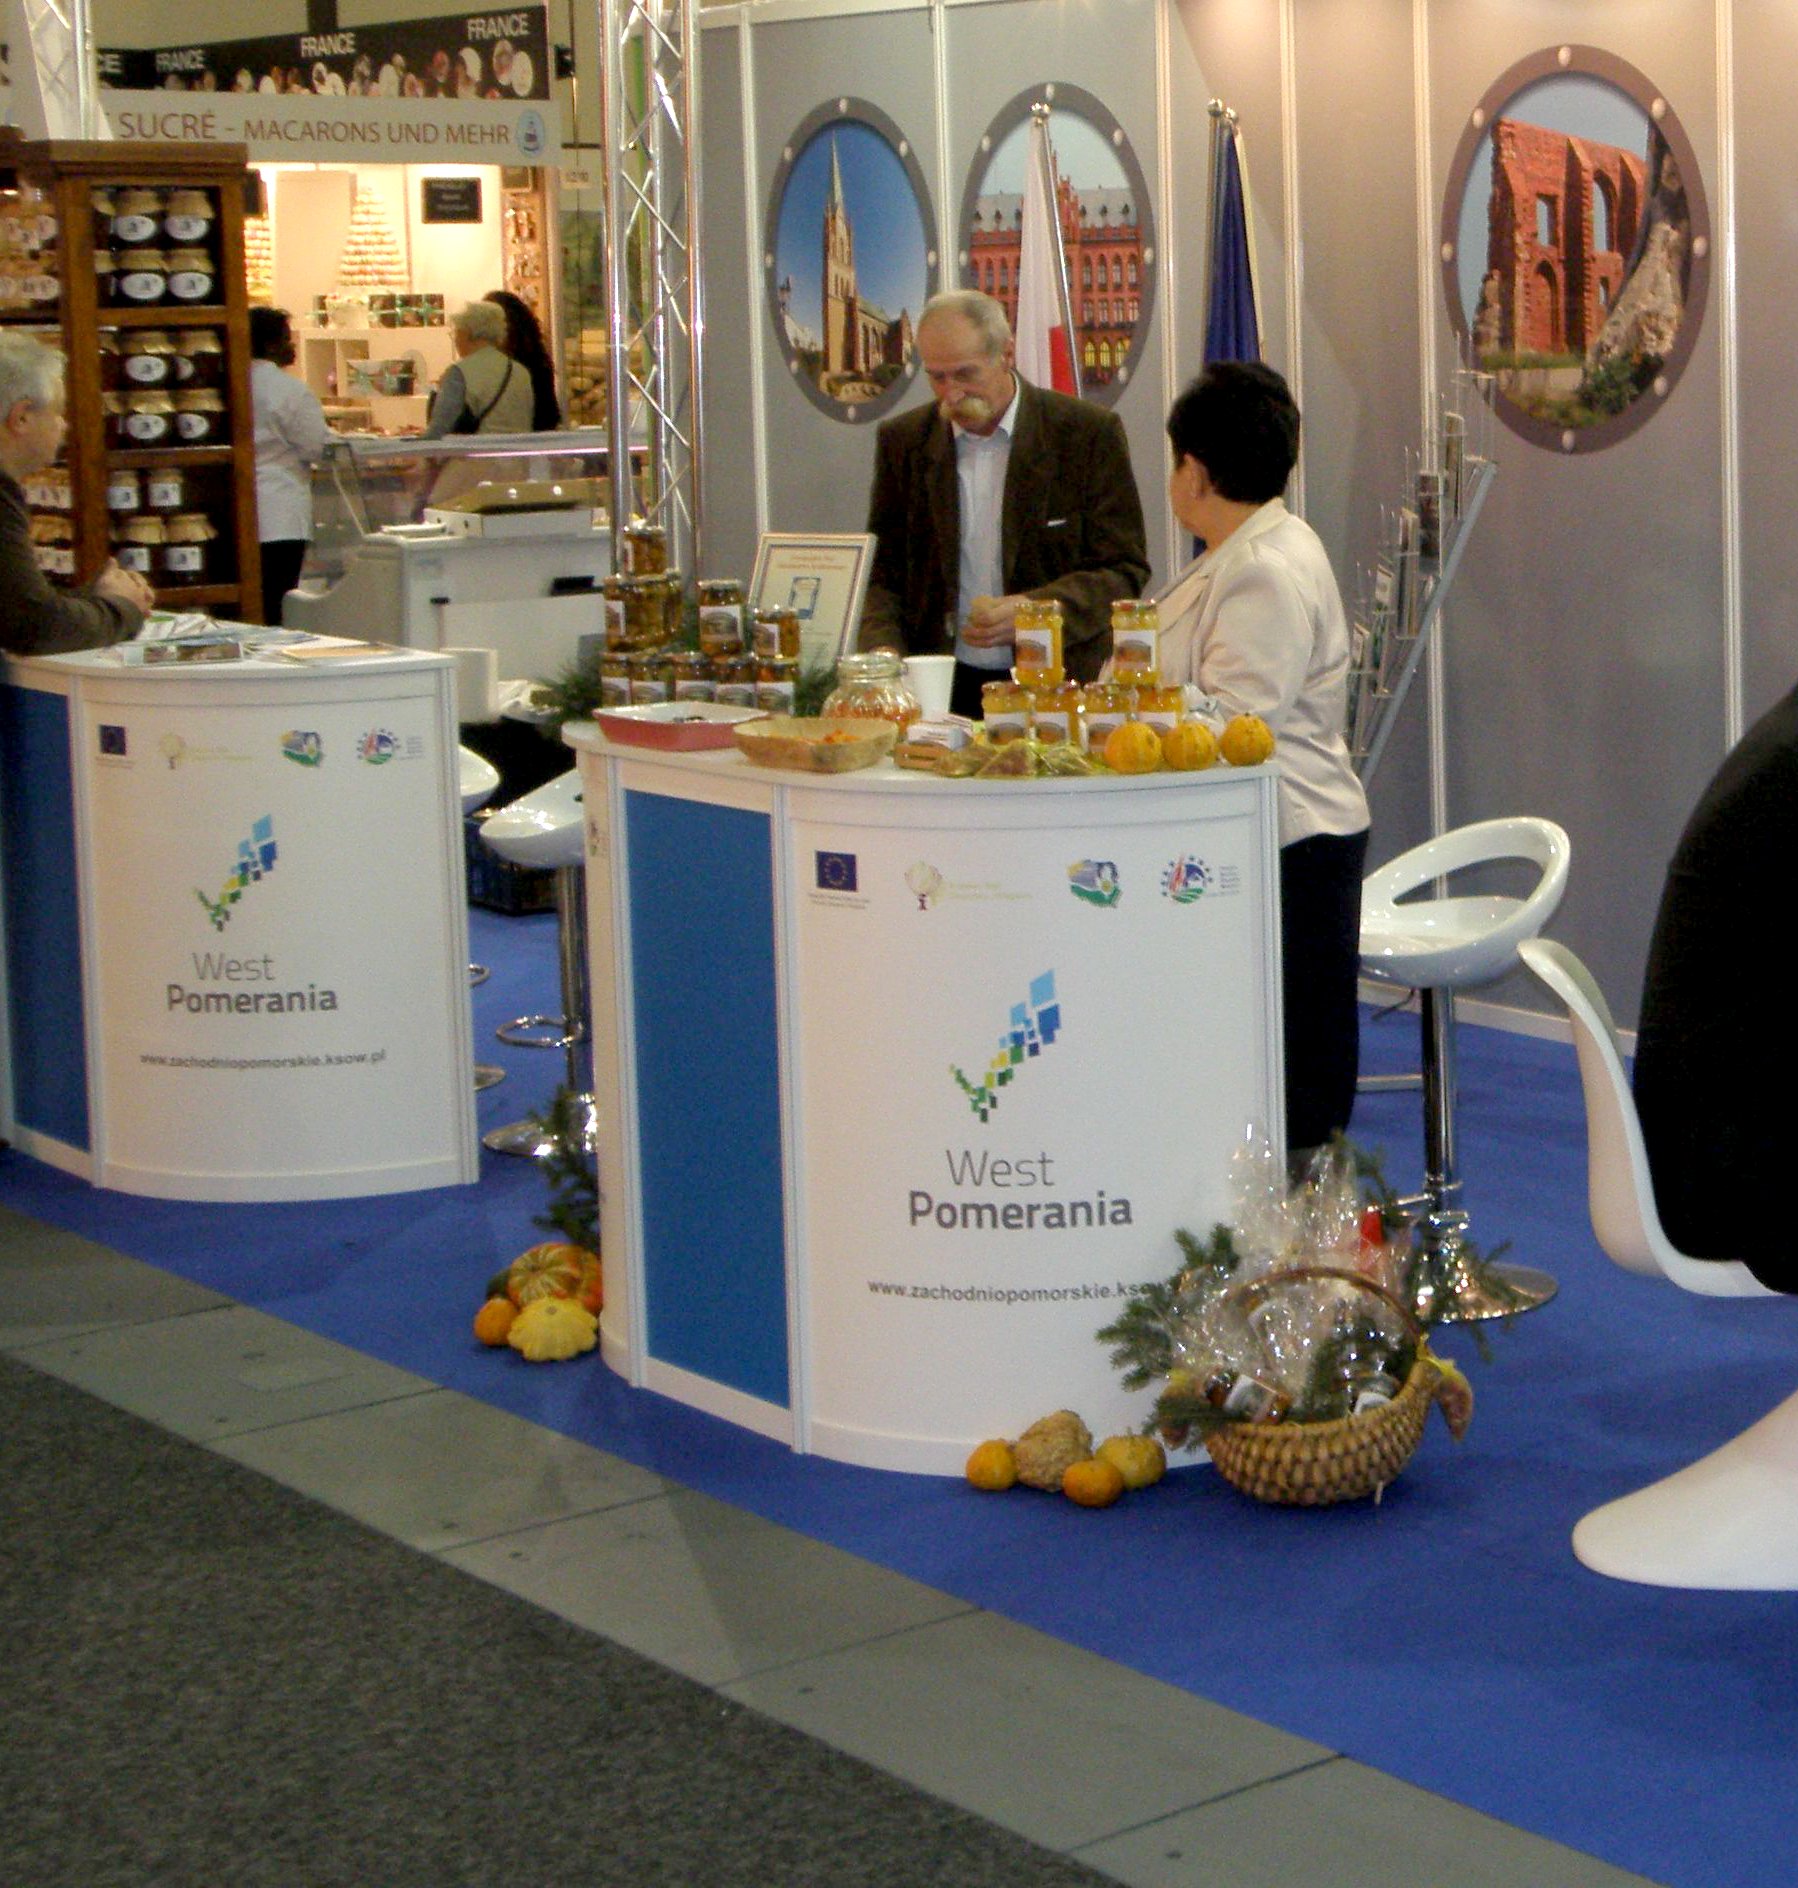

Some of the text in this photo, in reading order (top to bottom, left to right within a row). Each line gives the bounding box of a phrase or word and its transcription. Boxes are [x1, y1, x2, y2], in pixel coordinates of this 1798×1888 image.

[467, 13, 531, 40] FRANCE
[301, 32, 356, 57] FRANCE
[156, 50, 205, 72] FRANCE
[119, 109, 217, 140] SUCRÉ
[243, 118, 381, 144] MACARONS
[387, 123, 439, 145] UND
[446, 124, 511, 146] MEHR
[191, 951, 276, 982] West
[166, 982, 339, 1015] Pomerania
[945, 1149, 1056, 1188] West
[908, 1190, 1134, 1231] Pomerania
